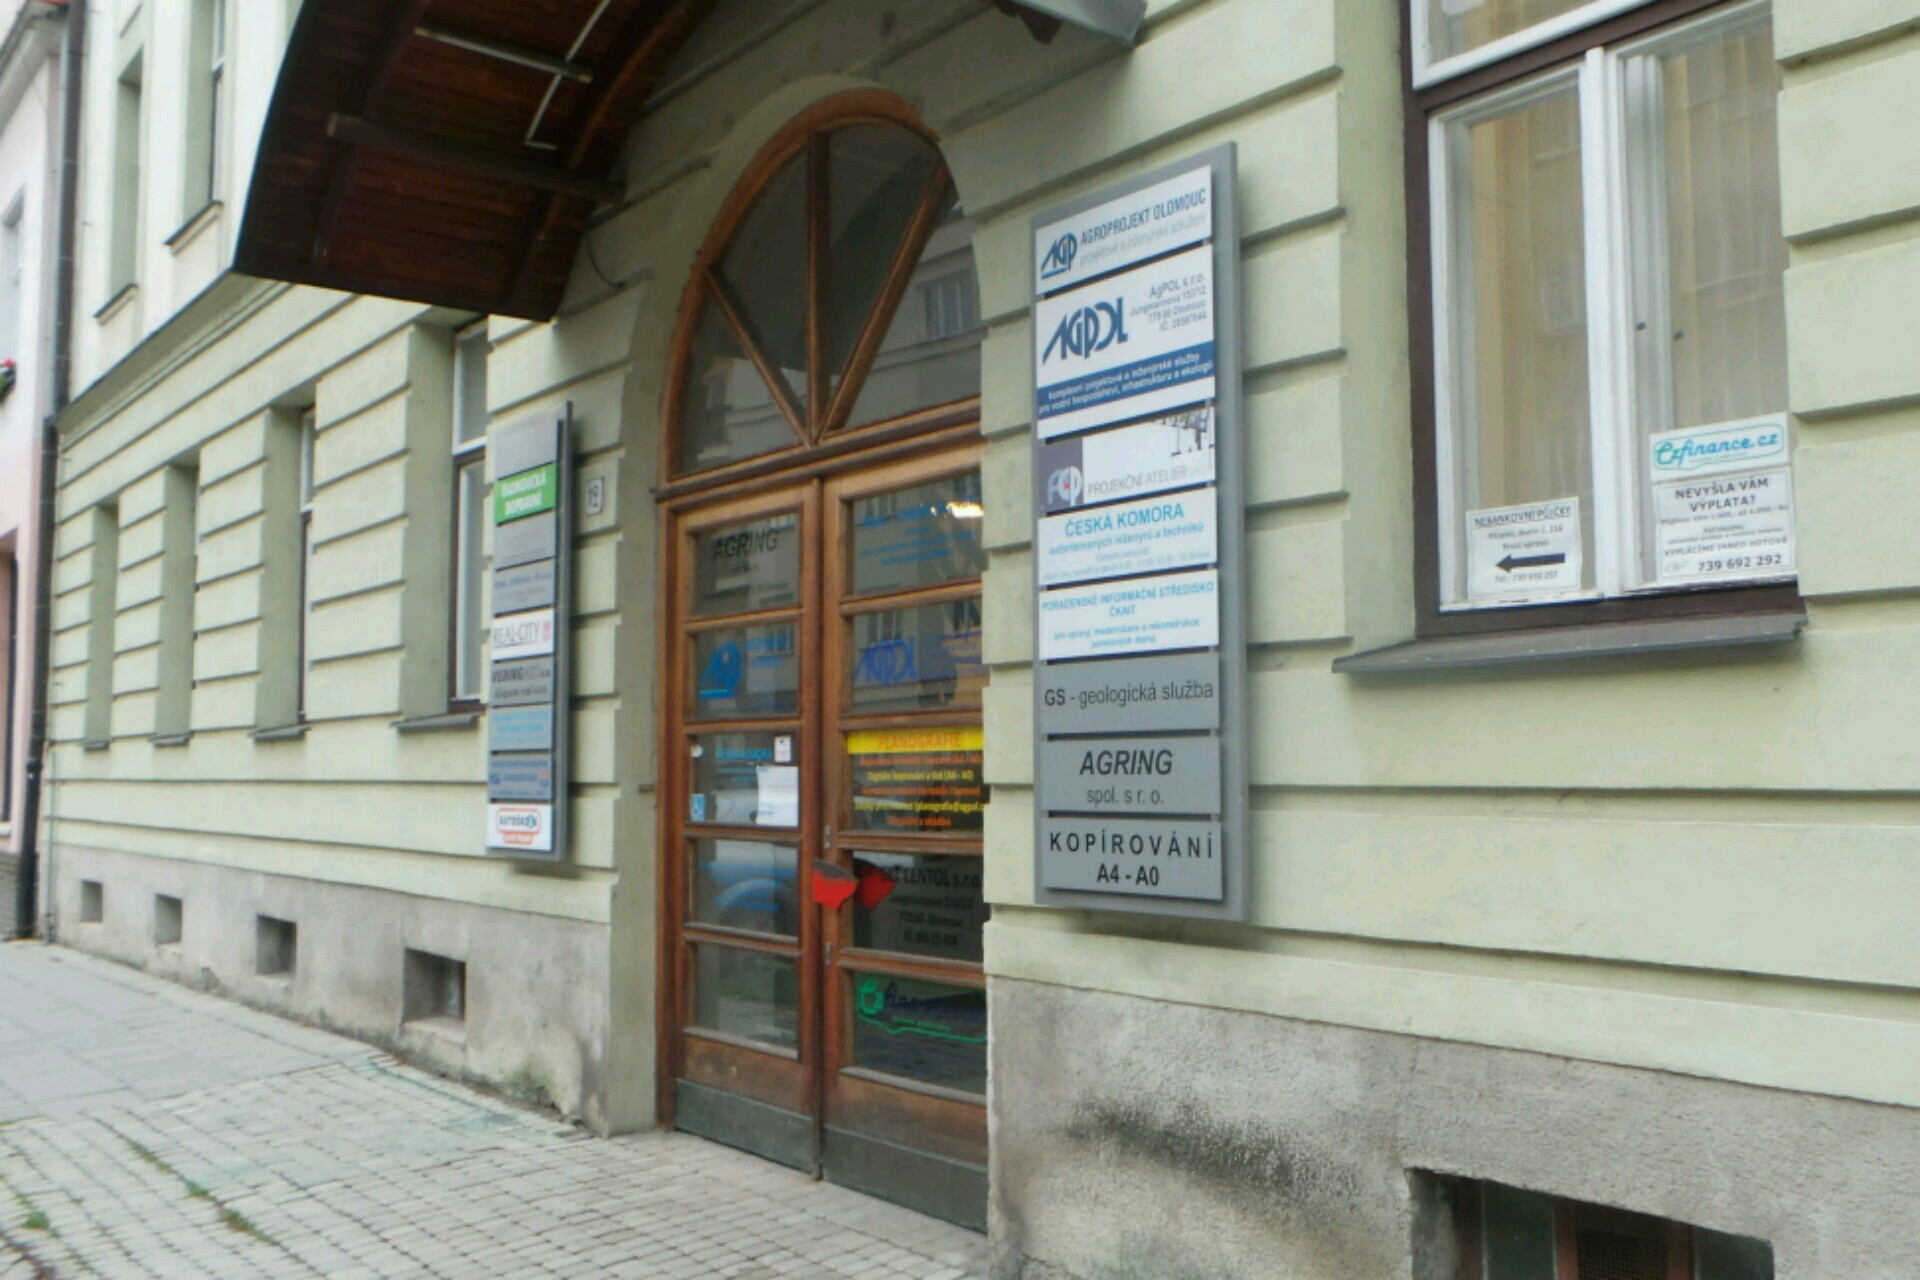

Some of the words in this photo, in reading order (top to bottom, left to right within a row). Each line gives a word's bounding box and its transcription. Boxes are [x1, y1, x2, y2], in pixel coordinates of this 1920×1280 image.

[1081, 208, 1150, 246] AGROPROJEKT
[1154, 188, 1206, 220] OLOMOUC
[1088, 473, 1142, 496] PROJEKČNÍ
[1675, 480, 1735, 499] NEVYŠLA
[1740, 475, 1769, 489] VÁM
[1690, 495, 1756, 512] VÝPLATA?
[1065, 512, 1113, 537] ČESKÁ
[1118, 503, 1184, 528] KOMORA
[712, 528, 779, 561] AGRING
[1697, 560, 1722, 572] 739
[1726, 556, 1751, 569] 692
[1756, 553, 1782, 567] 292
[1042, 593, 1098, 611] PORADENSKÉ
[1100, 587, 1156, 604] INFORMAČNÍ
[1159, 581, 1214, 598] STŘEDISKO
[1044, 688, 1066, 706] GS
[1079, 682, 1156, 710] geologická
[1162, 680, 1214, 700] služba
[1079, 749, 1173, 776] AGRING
[1087, 786, 1118, 807] spol.
[1049, 829, 1212, 859] KOPÍROVÁNÍ
[1097, 863, 1120, 884] A4
[1135, 865, 1160, 886] A0
